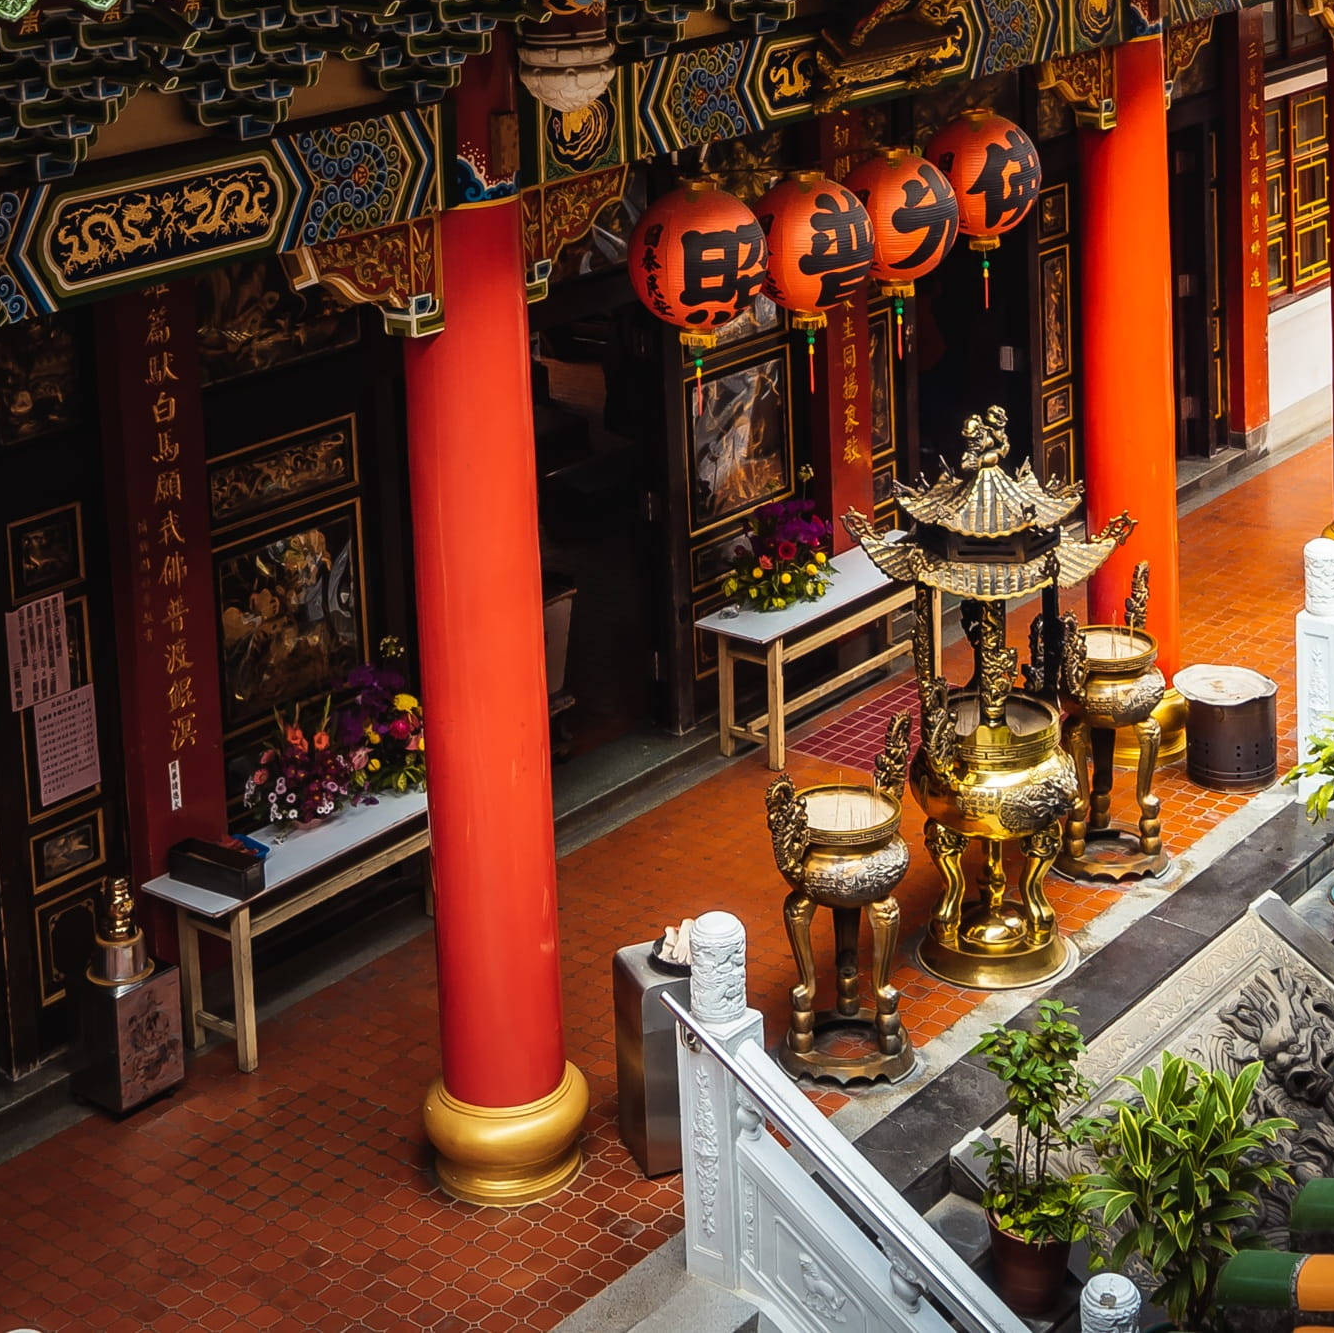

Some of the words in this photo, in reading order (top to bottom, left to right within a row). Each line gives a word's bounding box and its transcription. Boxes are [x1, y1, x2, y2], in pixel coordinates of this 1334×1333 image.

[891, 164, 959, 269] 光
[967, 129, 1040, 227] 佛
[679, 220, 769, 326] 照
[799, 189, 875, 307] 普
